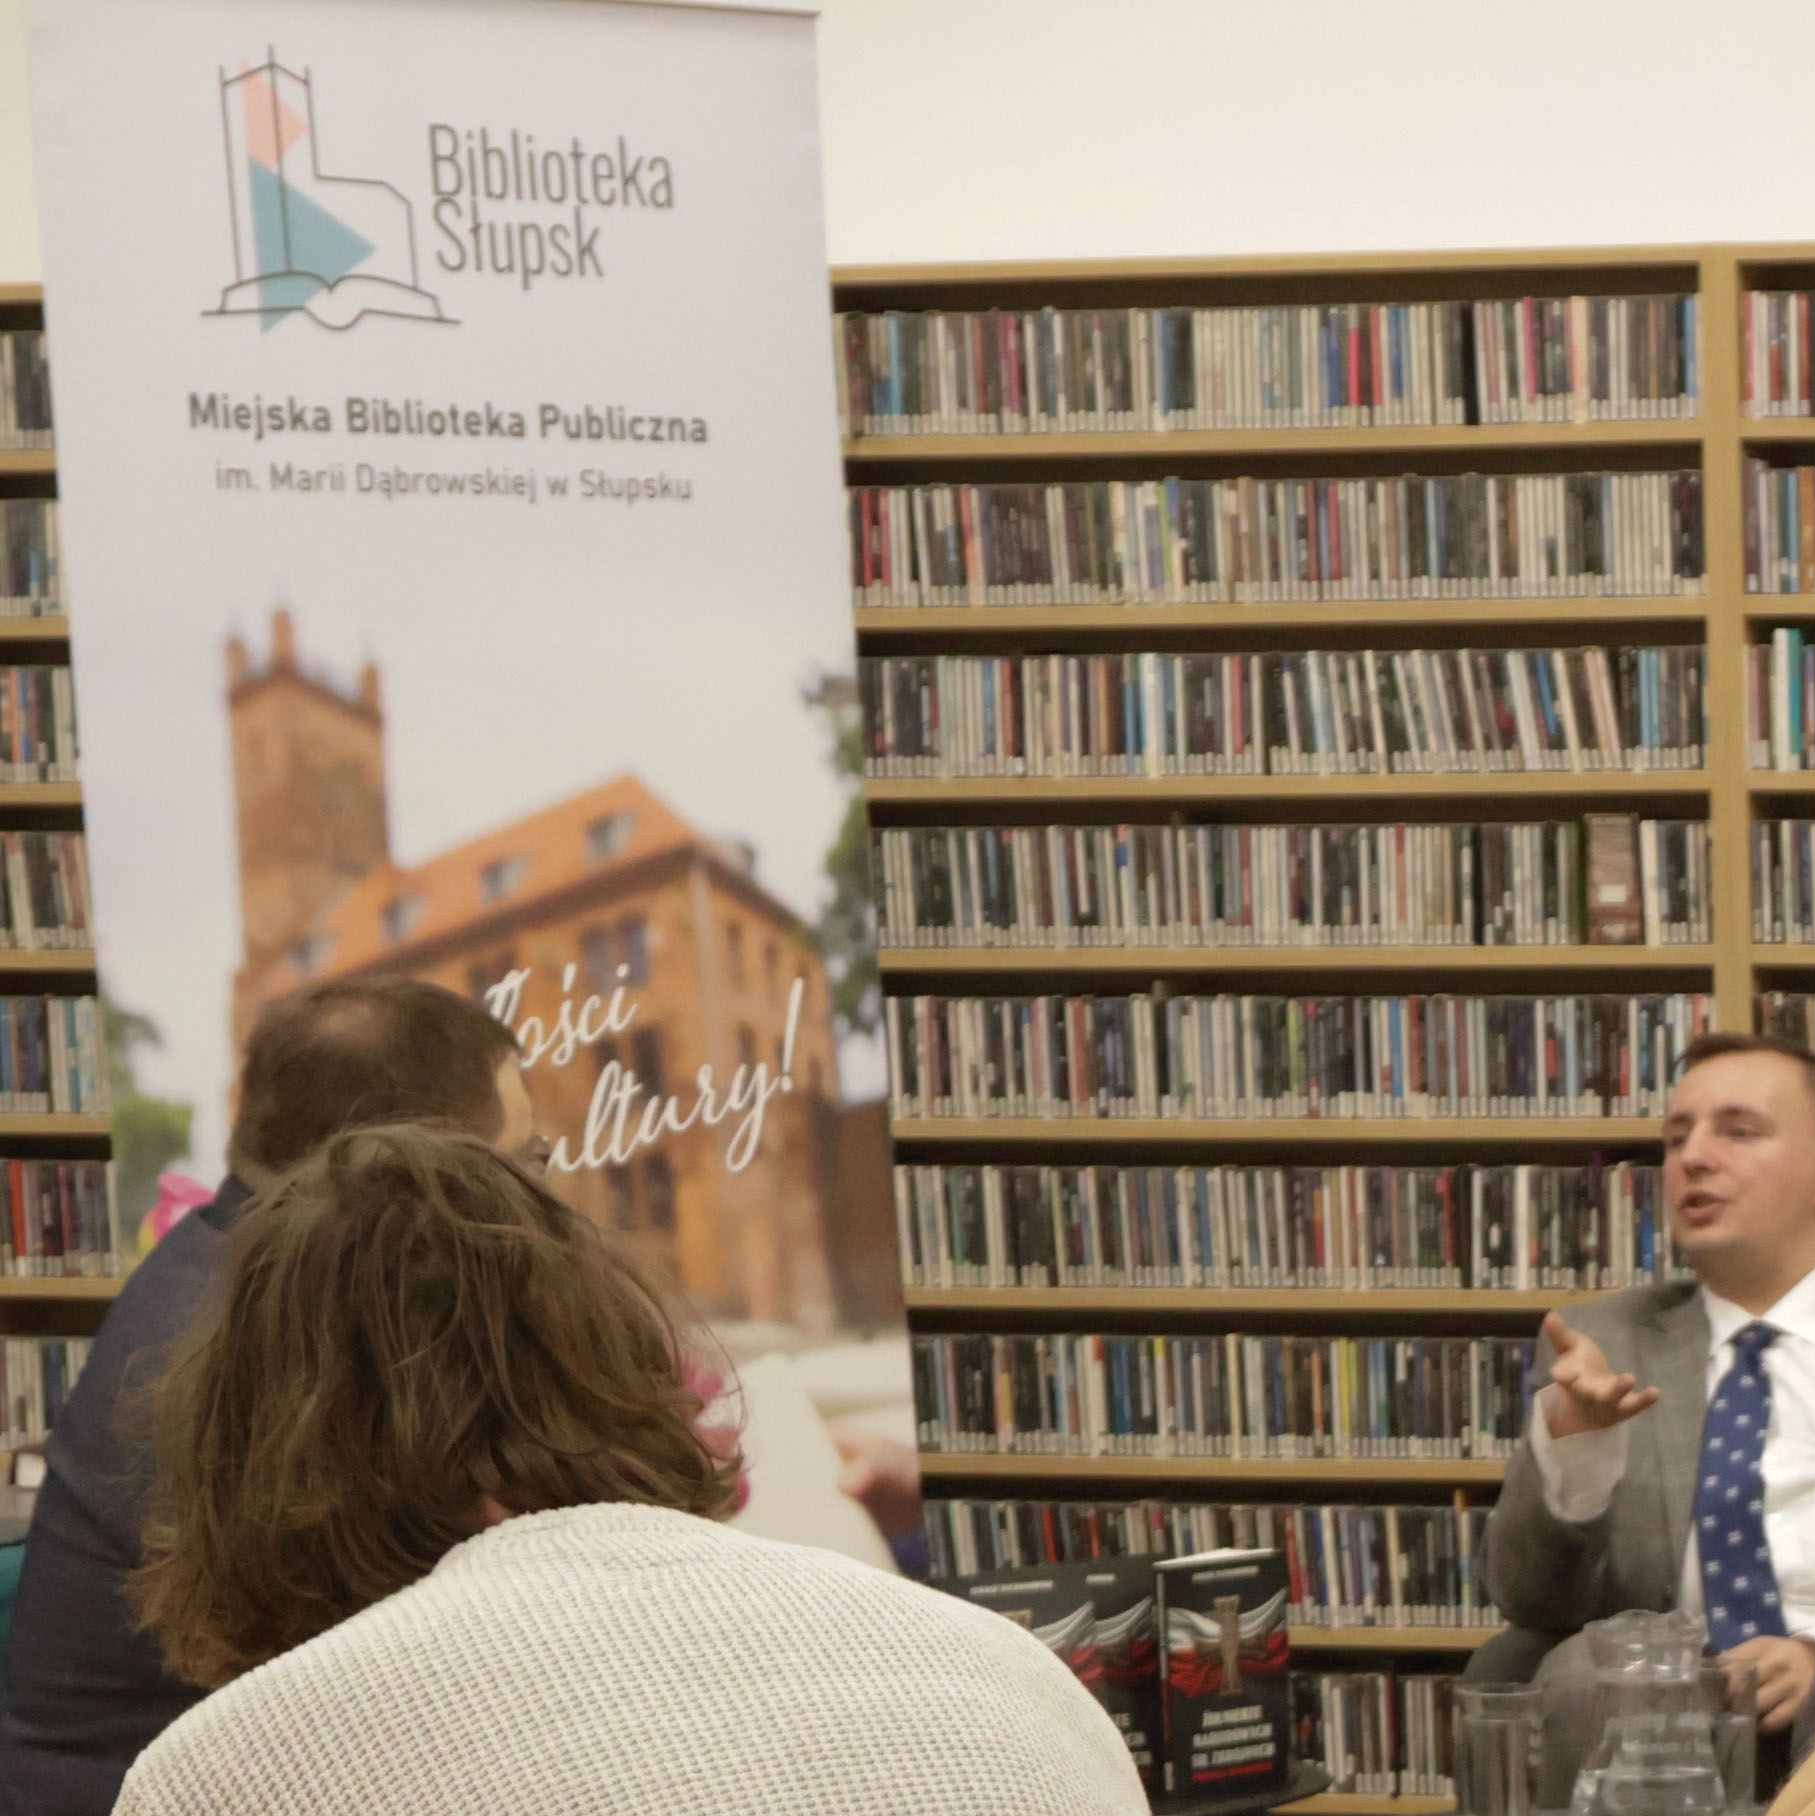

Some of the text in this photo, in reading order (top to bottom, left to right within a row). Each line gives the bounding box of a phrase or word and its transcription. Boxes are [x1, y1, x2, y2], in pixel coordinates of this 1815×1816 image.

[428, 122, 674, 209] Biblioteka
[433, 197, 604, 291] Słupsk
[188, 392, 709, 443] Miejska Biblioteka Publiczna
[214, 456, 692, 507] im. Marii Dąbrowskiej w Słupsku
